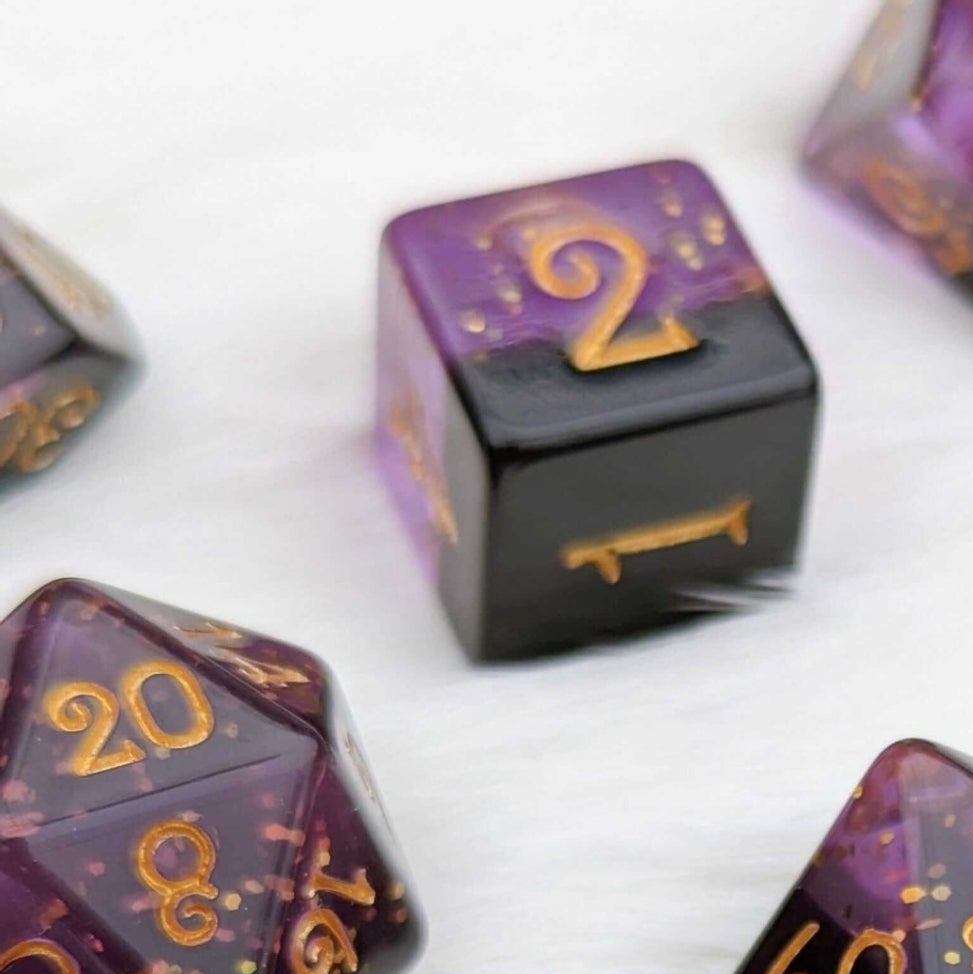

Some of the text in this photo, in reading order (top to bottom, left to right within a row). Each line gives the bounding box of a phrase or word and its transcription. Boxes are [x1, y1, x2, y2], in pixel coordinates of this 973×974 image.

[529, 222, 701, 371] 2
[45, 660, 216, 777] 20
[134, 818, 218, 947] 8
